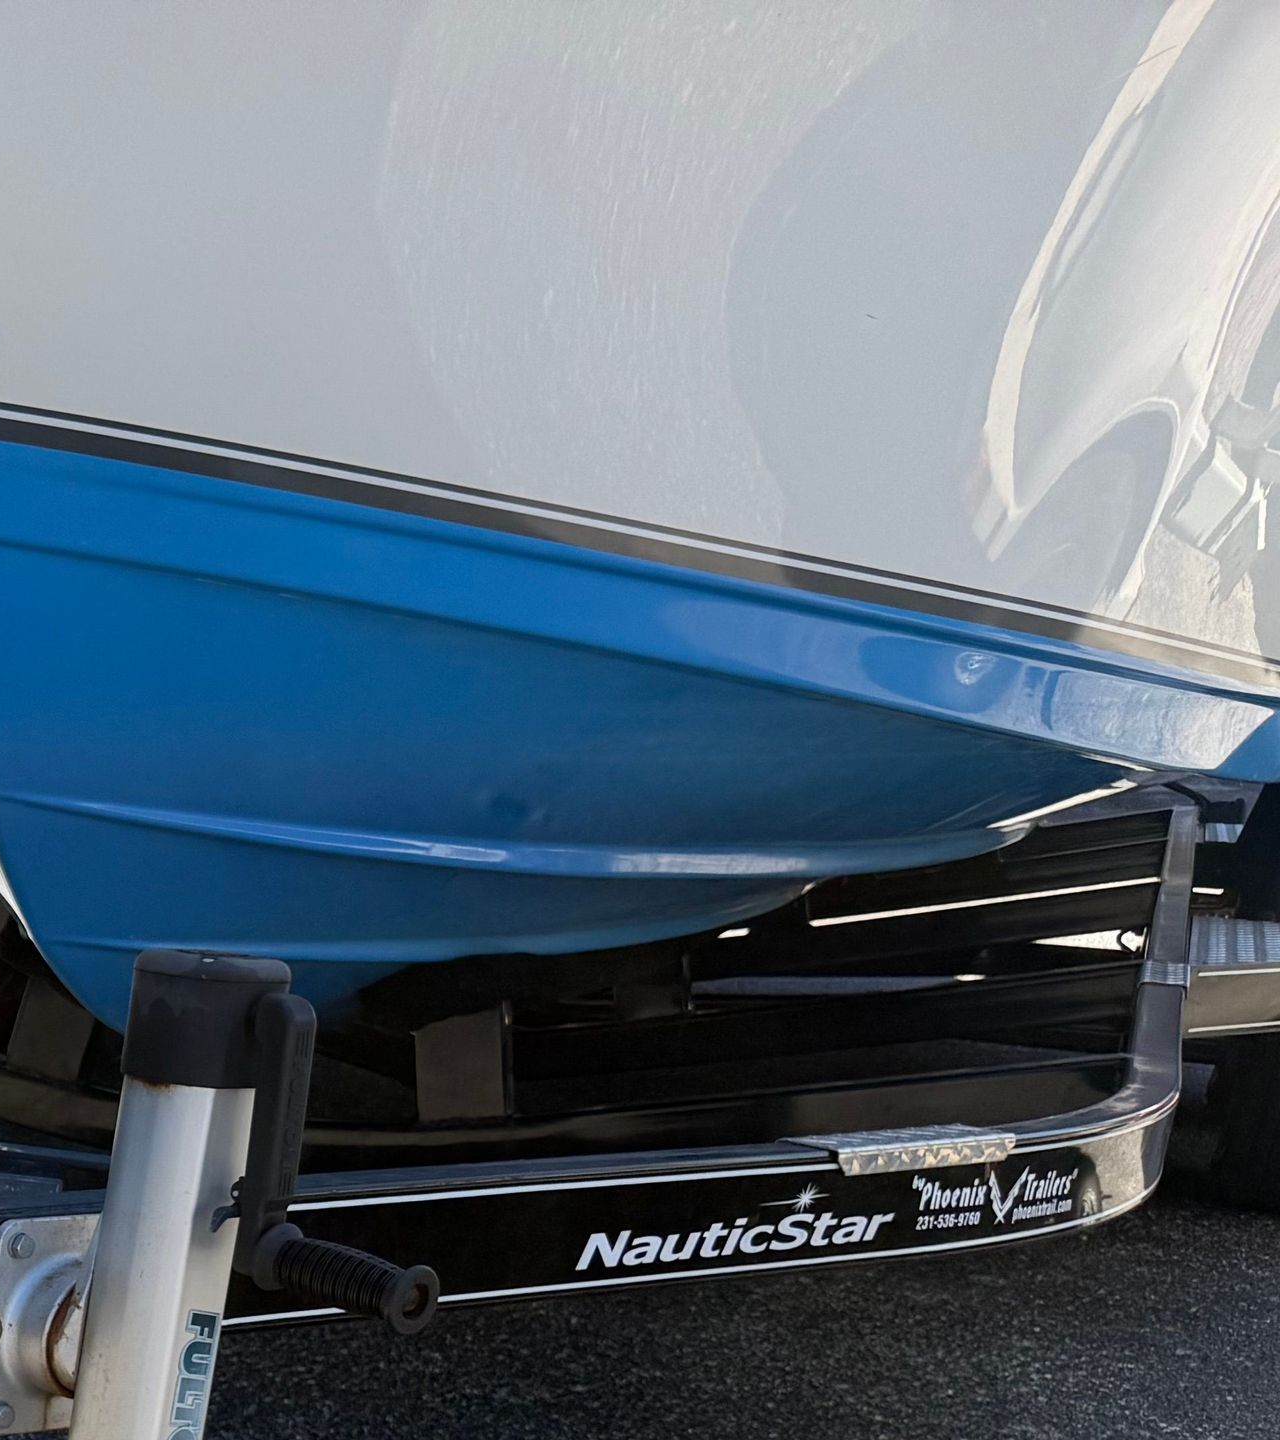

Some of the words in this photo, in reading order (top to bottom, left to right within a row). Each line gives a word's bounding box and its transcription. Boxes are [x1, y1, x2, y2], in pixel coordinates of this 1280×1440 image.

[912, 1174, 926, 1191] by
[919, 1178, 987, 1211] Phoenix
[915, 1211, 981, 1231] 231-536-9760
[1011, 1199, 1073, 1224] phoenixtrail.com
[575, 1211, 895, 1271] NauticStar
